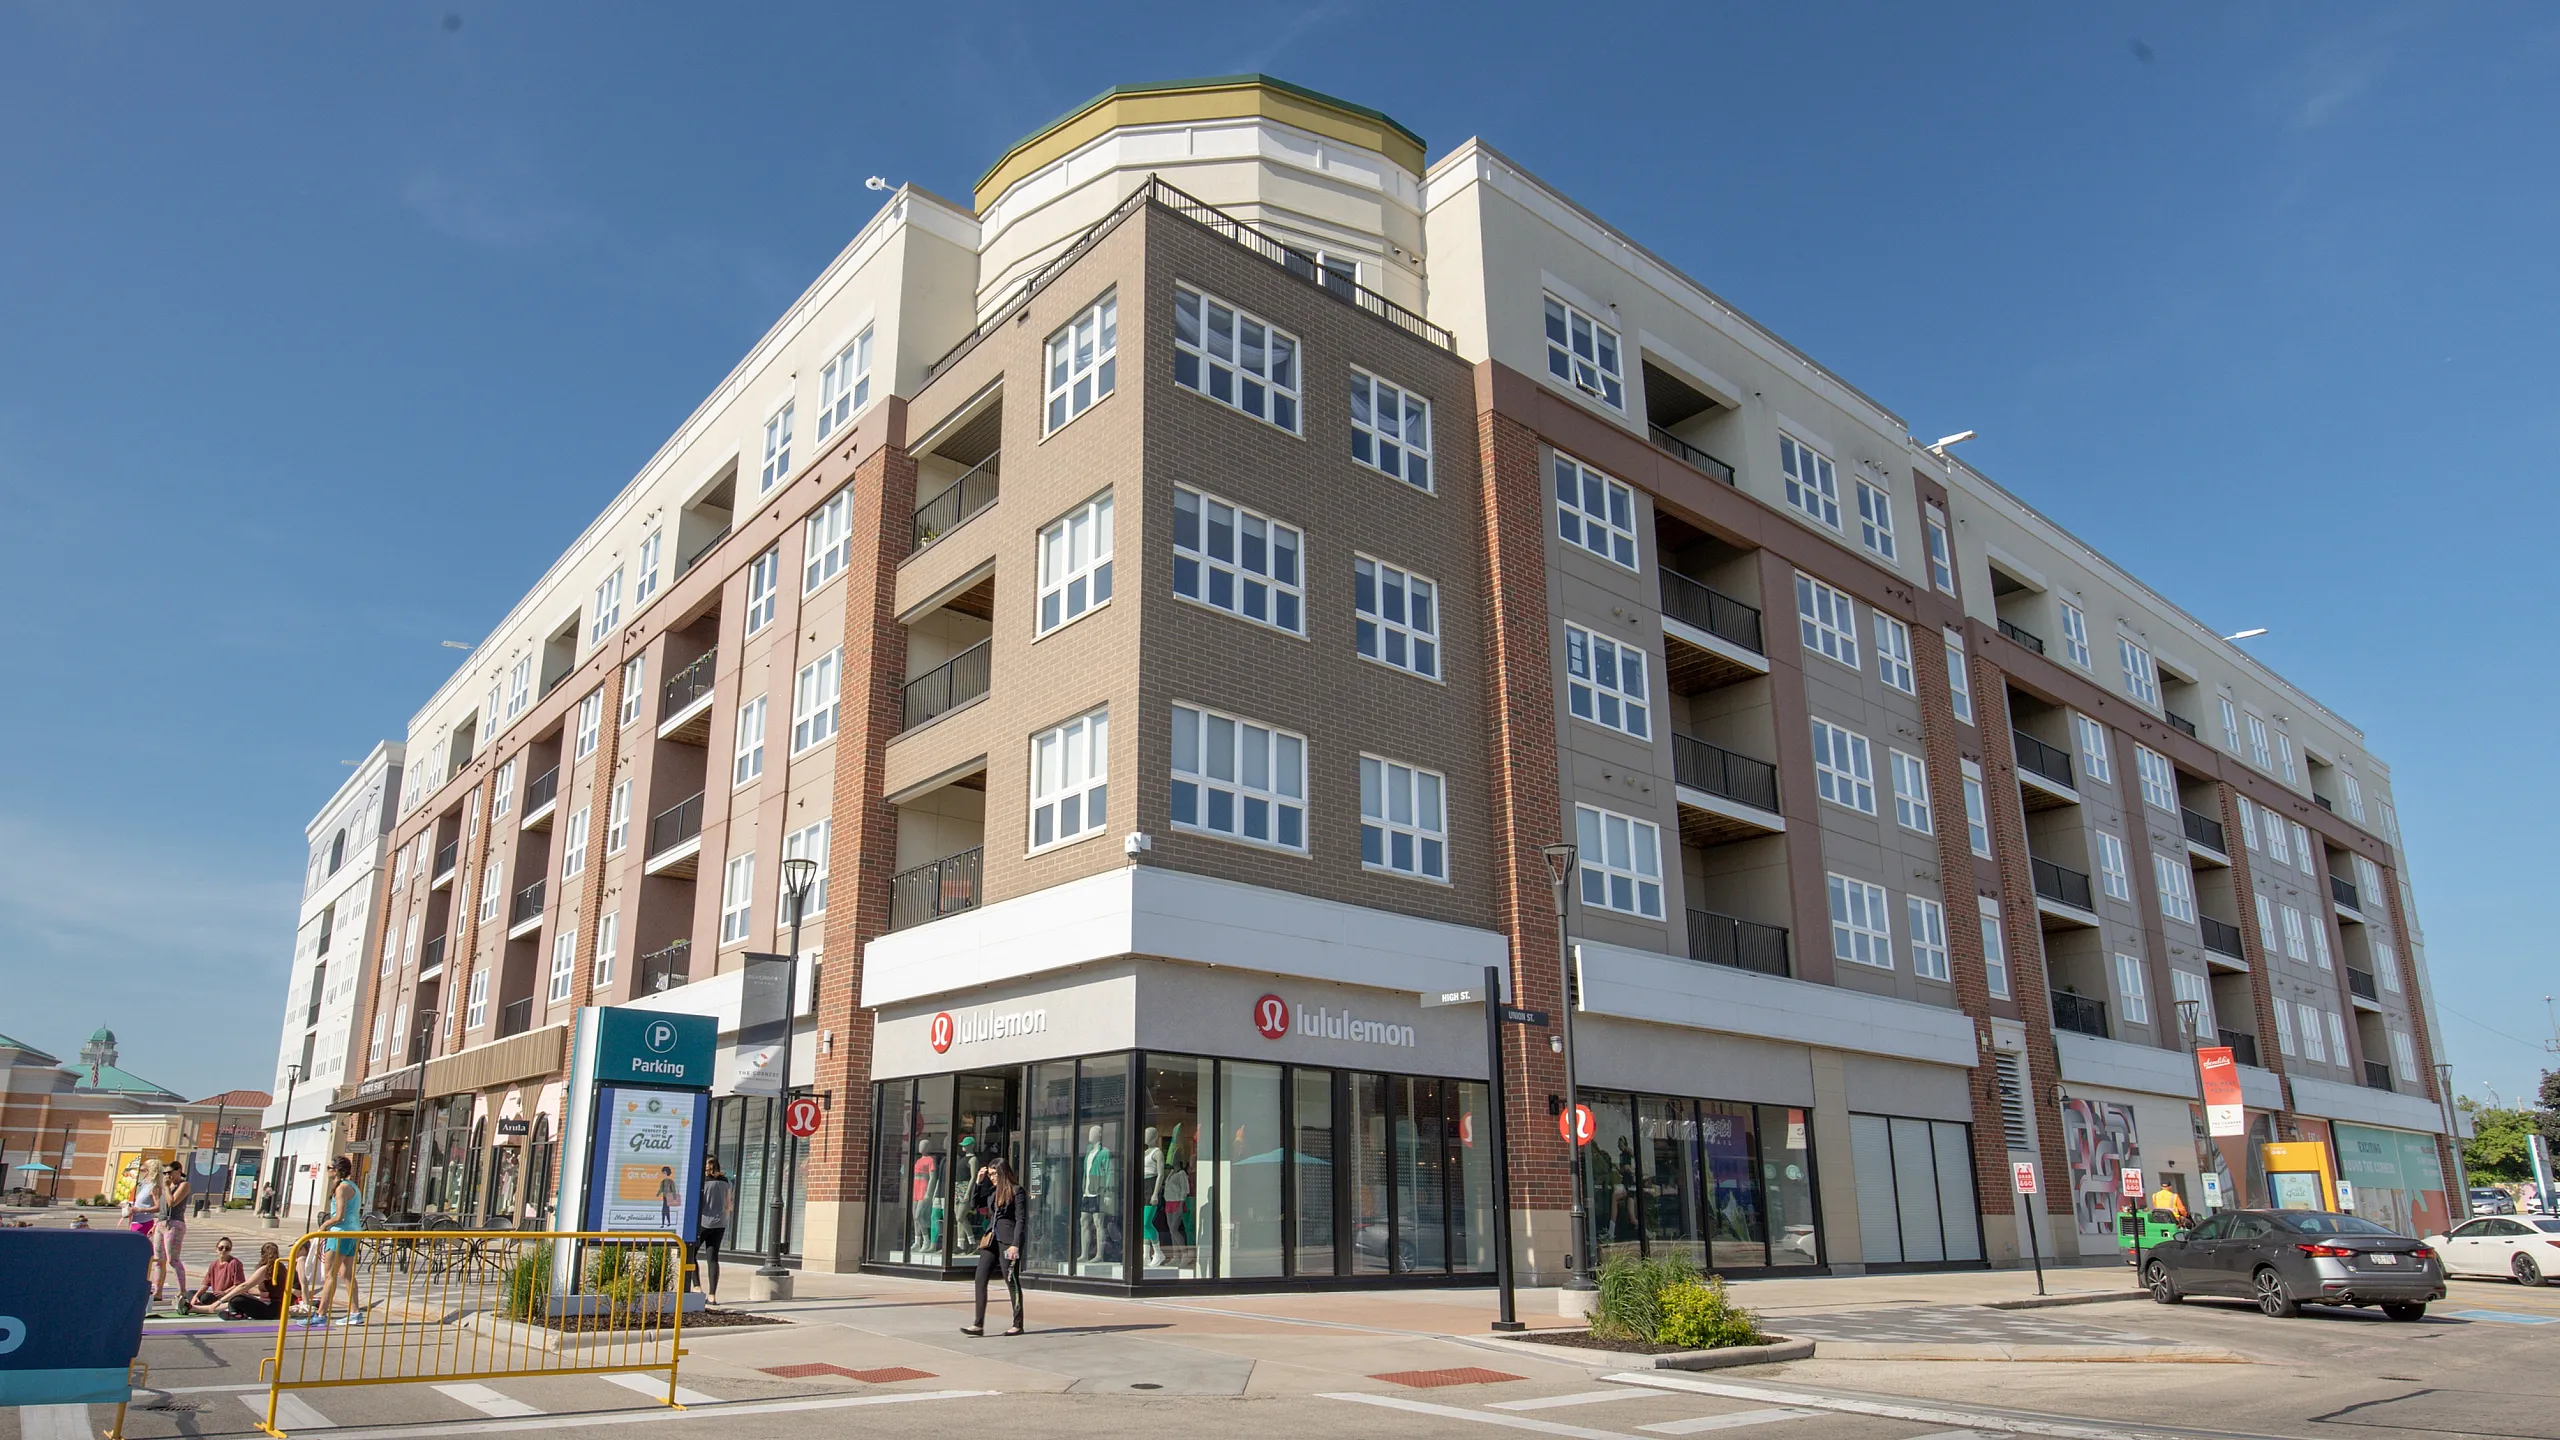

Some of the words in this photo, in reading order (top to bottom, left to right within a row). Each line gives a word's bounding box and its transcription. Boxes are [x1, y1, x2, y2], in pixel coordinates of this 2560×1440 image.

[1441, 992, 1459, 1003] HIGH
[1460, 991, 1471, 1001] ST.
[1296, 1003, 1415, 1048] lululemon
[1508, 1010, 1526, 1021] UNION
[1526, 1013, 1535, 1022] ST.
[654, 1026, 671, 1047] P
[957, 1009, 1047, 1045] lululemon
[632, 1057, 684, 1078] Parking
[752, 1070, 780, 1078] CORNERS
[502, 1123, 526, 1132] Arula
[629, 1133, 673, 1152] Grad
